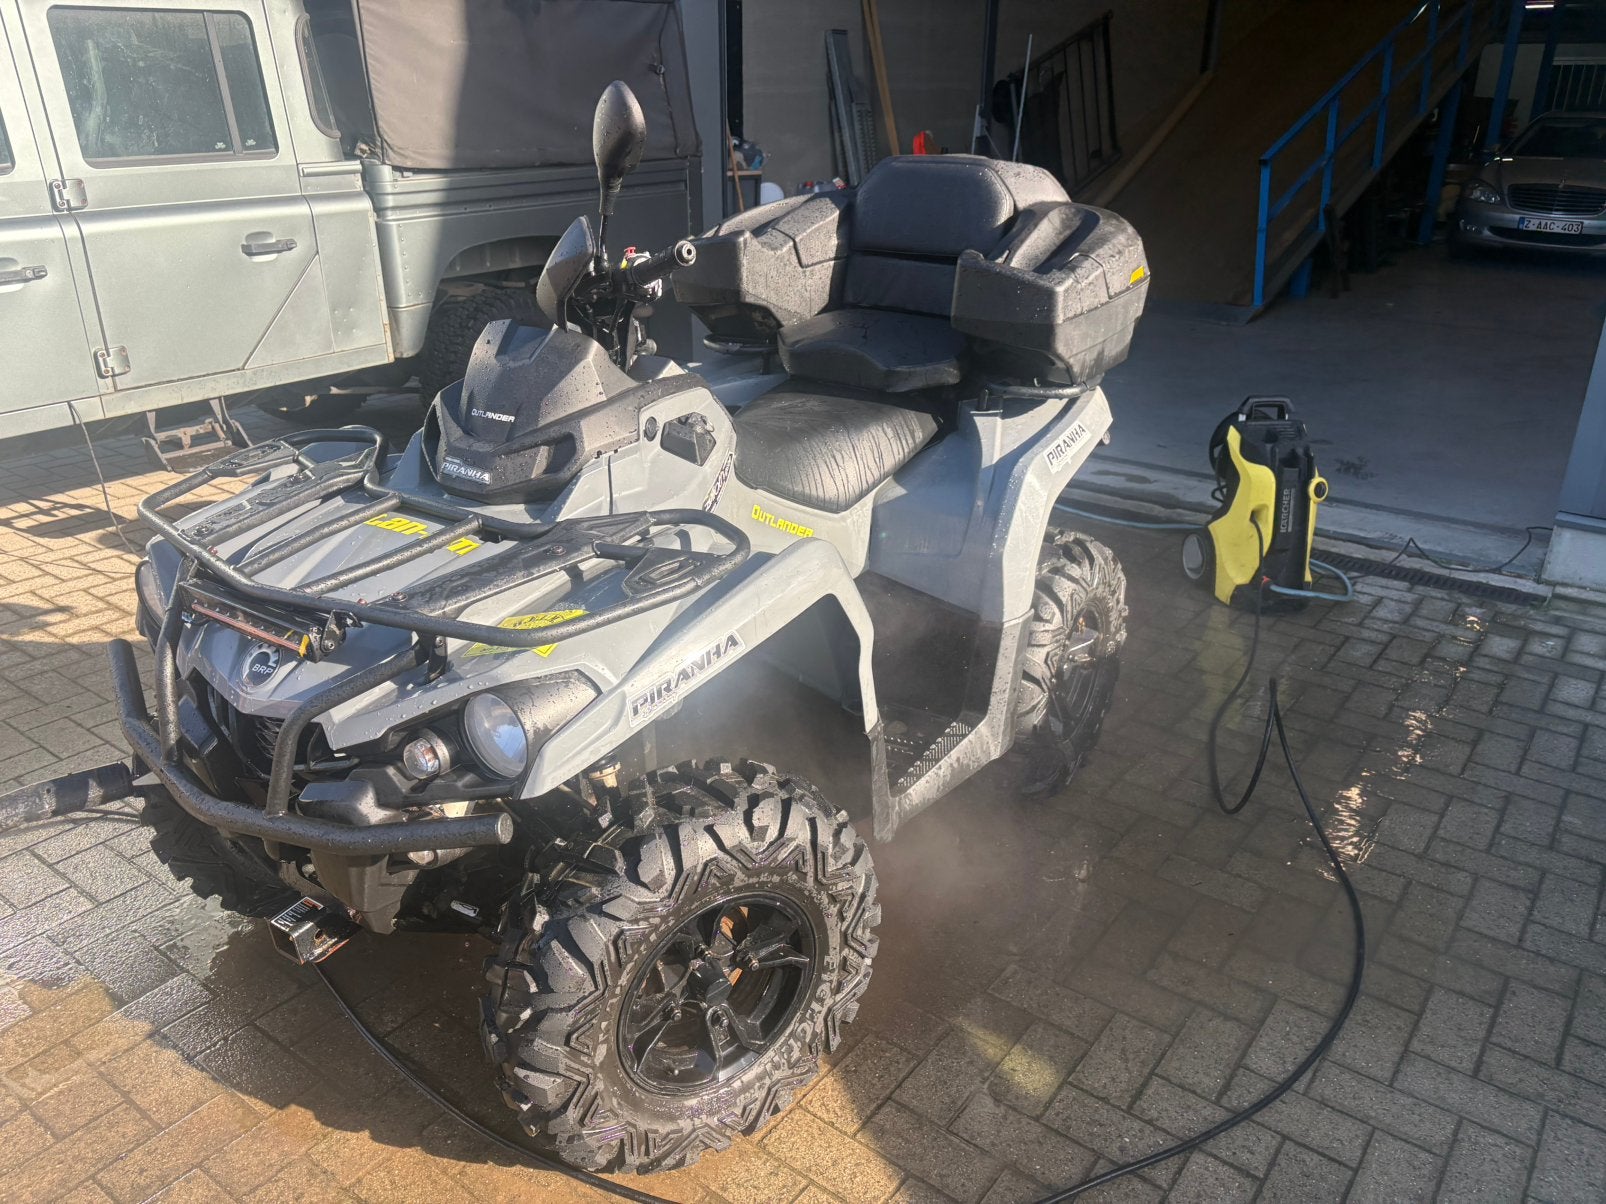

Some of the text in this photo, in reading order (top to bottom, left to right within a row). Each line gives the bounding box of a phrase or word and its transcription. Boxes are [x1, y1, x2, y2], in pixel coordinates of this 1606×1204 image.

[1524, 219, 1581, 233] Z-AAC-403
[471, 408, 515, 423] OUTLANDER
[1047, 424, 1086, 466] PIRANHA
[442, 461, 491, 481] PIRANHA
[252, 663, 274, 675] BRP
[632, 634, 739, 717] PIRANHA
